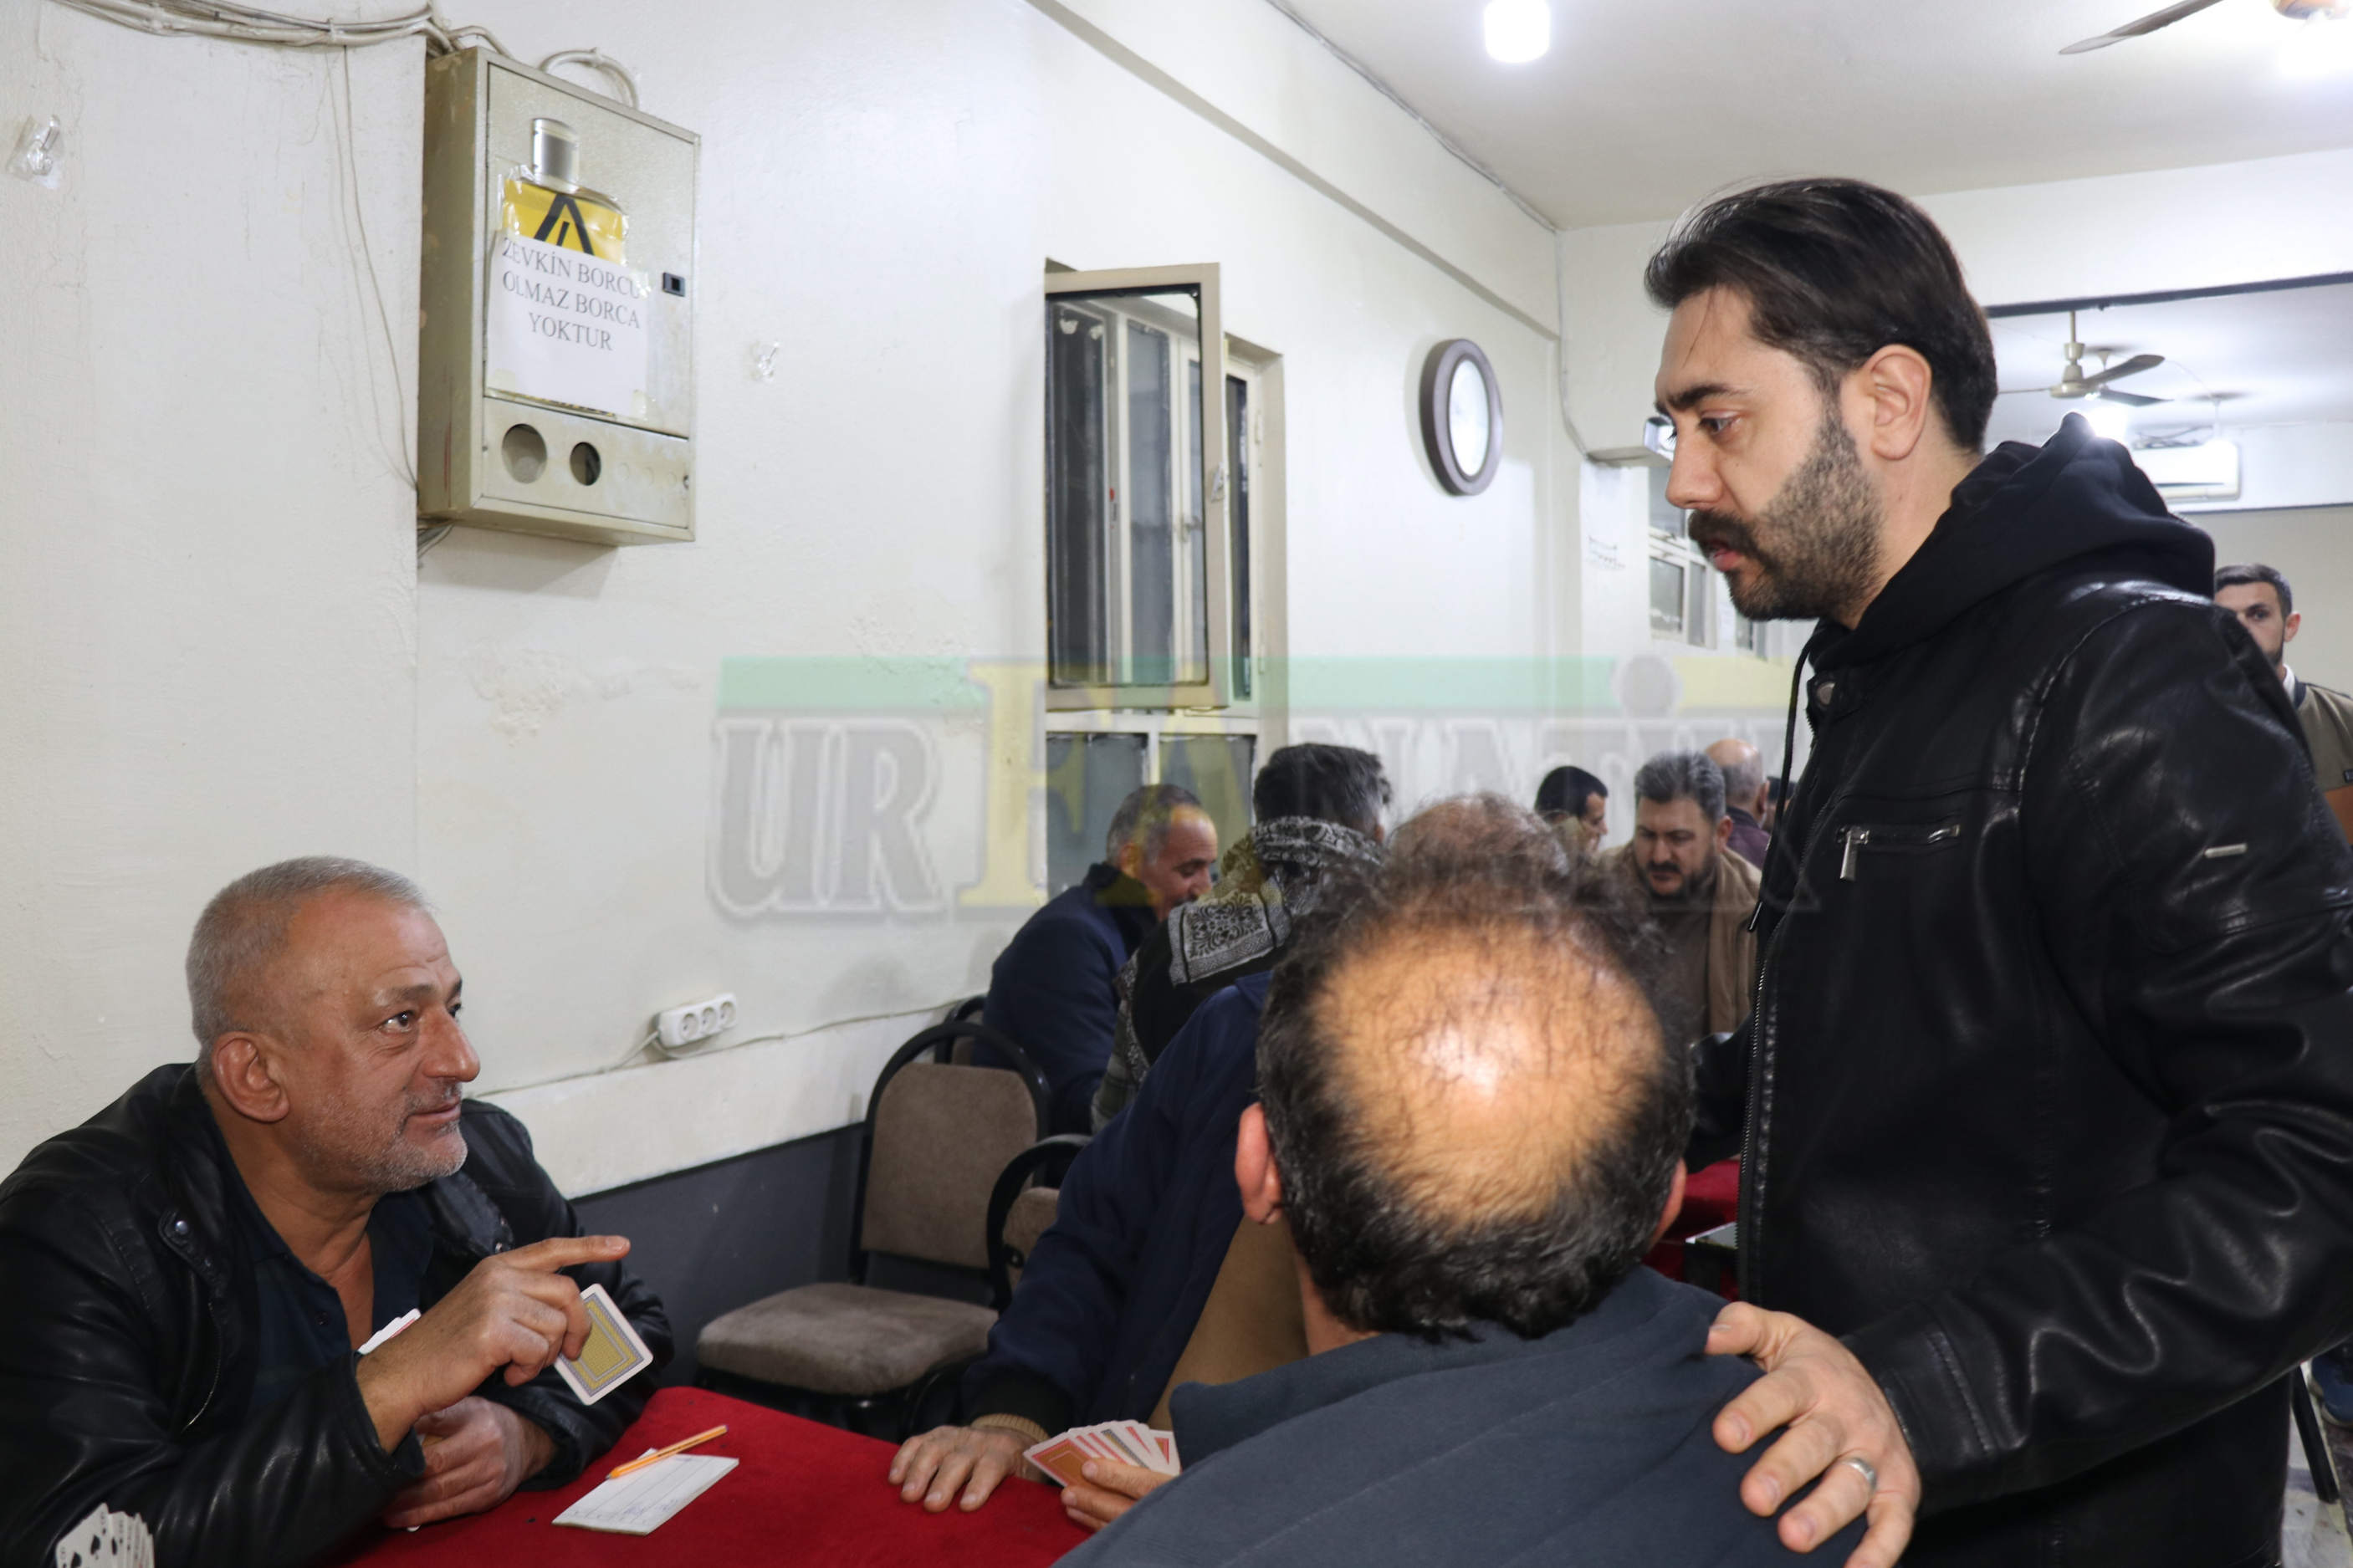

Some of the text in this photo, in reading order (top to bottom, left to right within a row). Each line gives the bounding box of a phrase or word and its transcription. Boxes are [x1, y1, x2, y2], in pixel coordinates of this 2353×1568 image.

[503, 271, 641, 329] OLMAZ BORCA
[529, 312, 613, 351] YOKTUR
